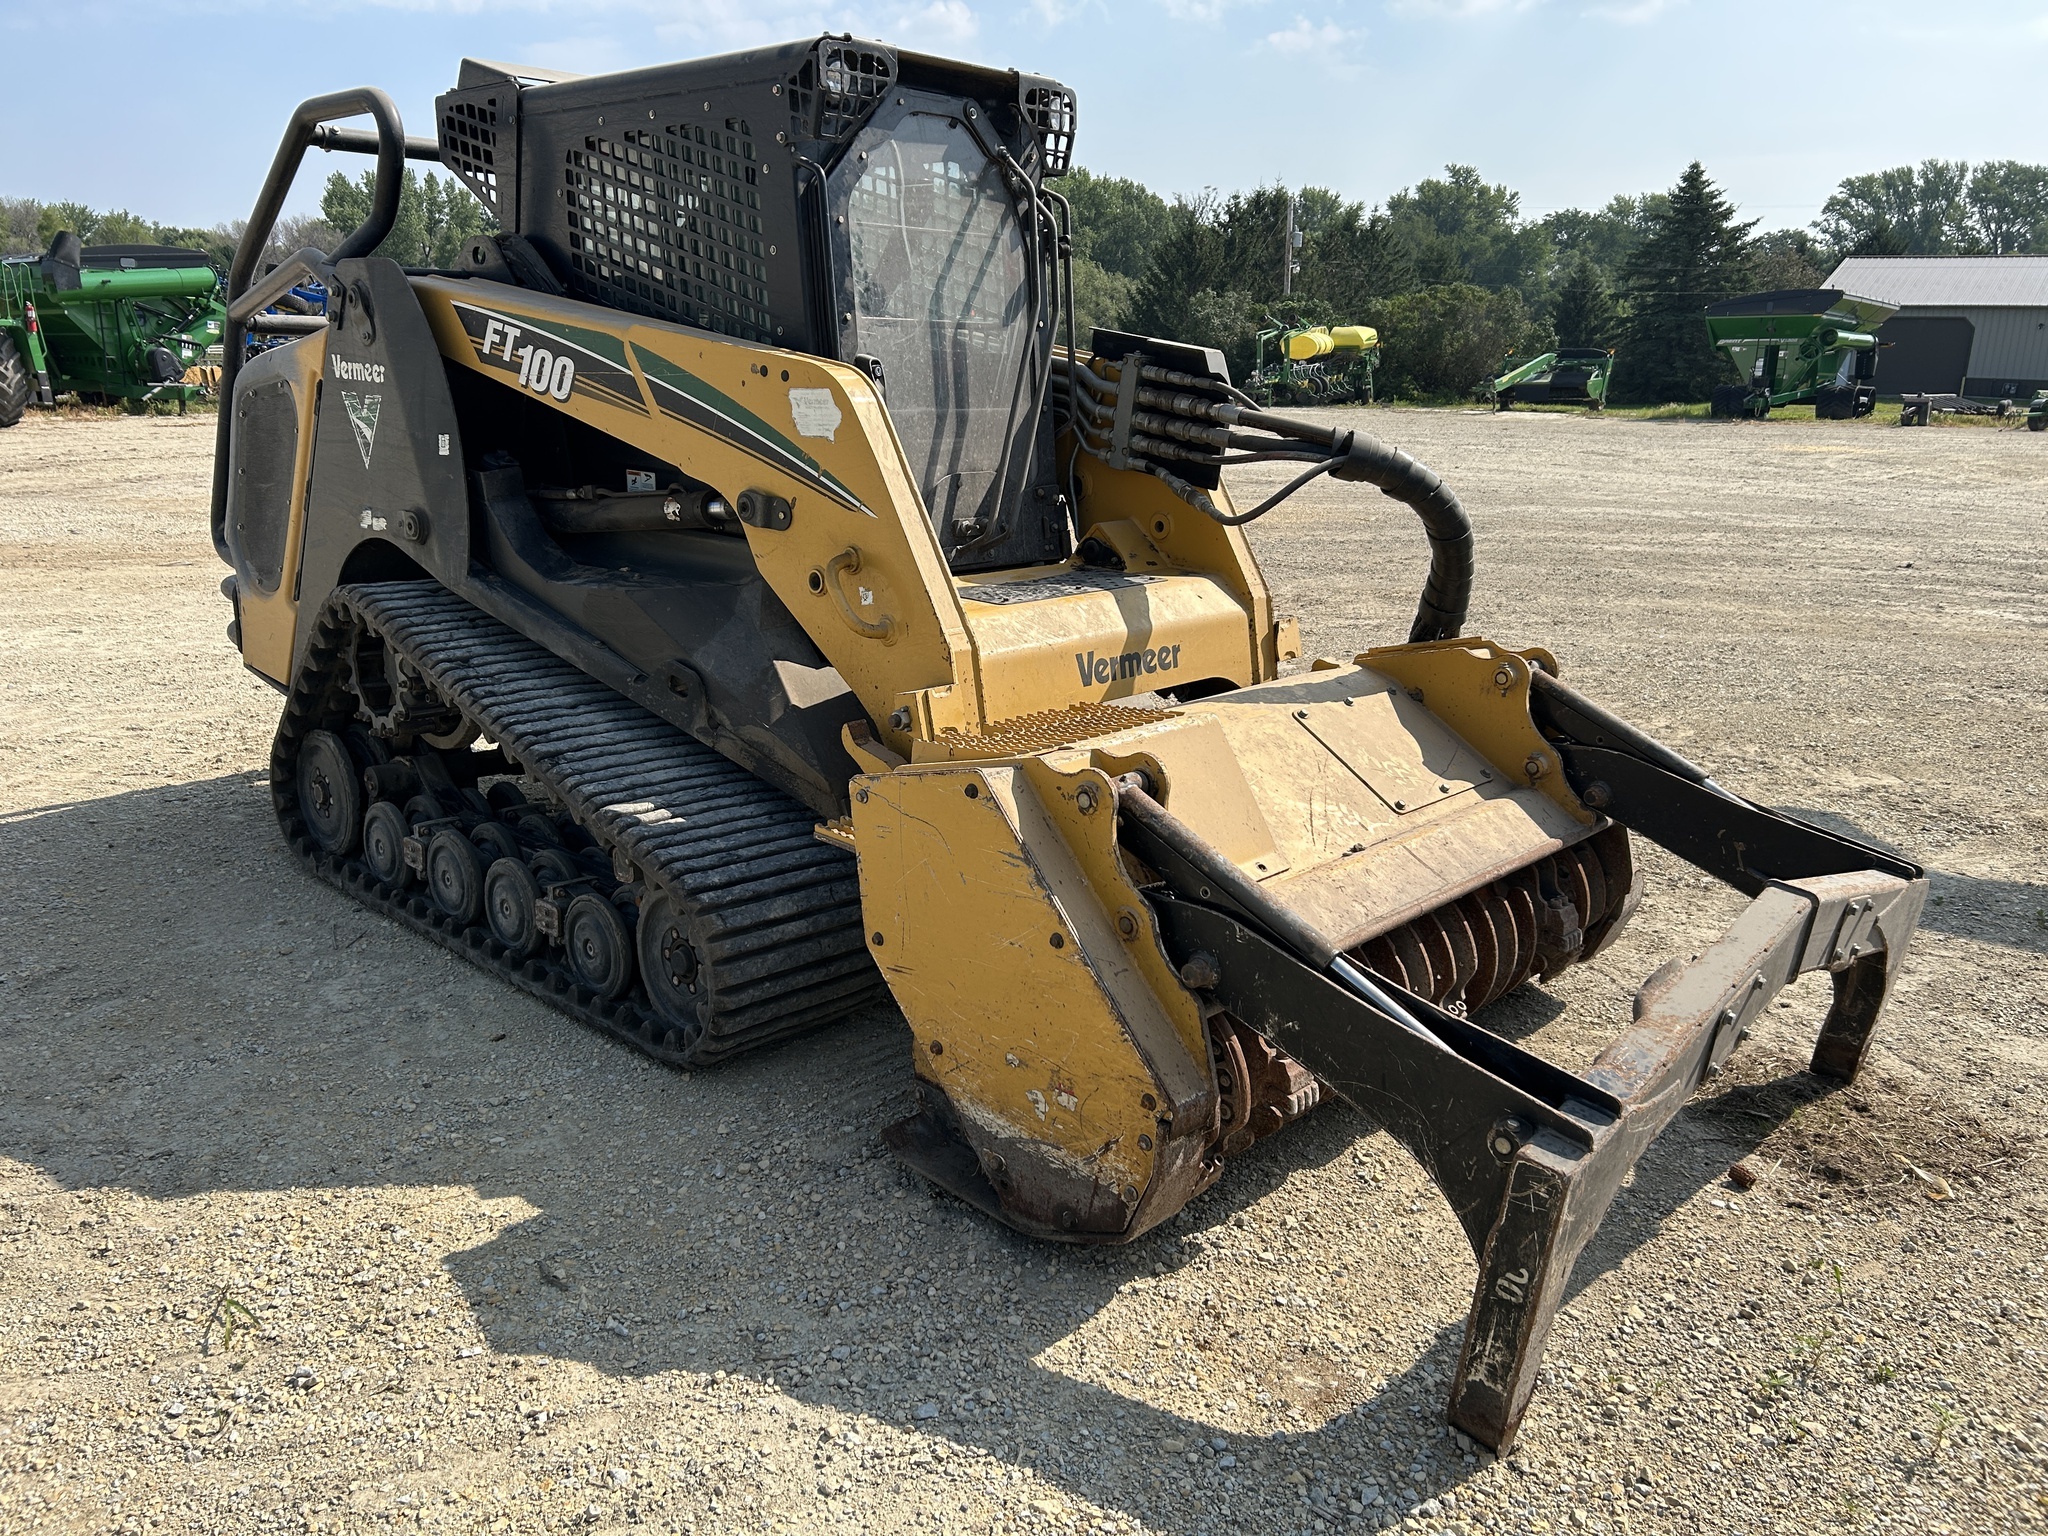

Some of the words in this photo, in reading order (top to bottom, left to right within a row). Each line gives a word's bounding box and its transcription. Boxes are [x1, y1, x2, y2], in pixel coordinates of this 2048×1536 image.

[331, 353, 386, 383] Vermeer
[482, 318, 521, 362] FT
[518, 344, 575, 399] 100
[1075, 644, 1181, 688] Vermeer
